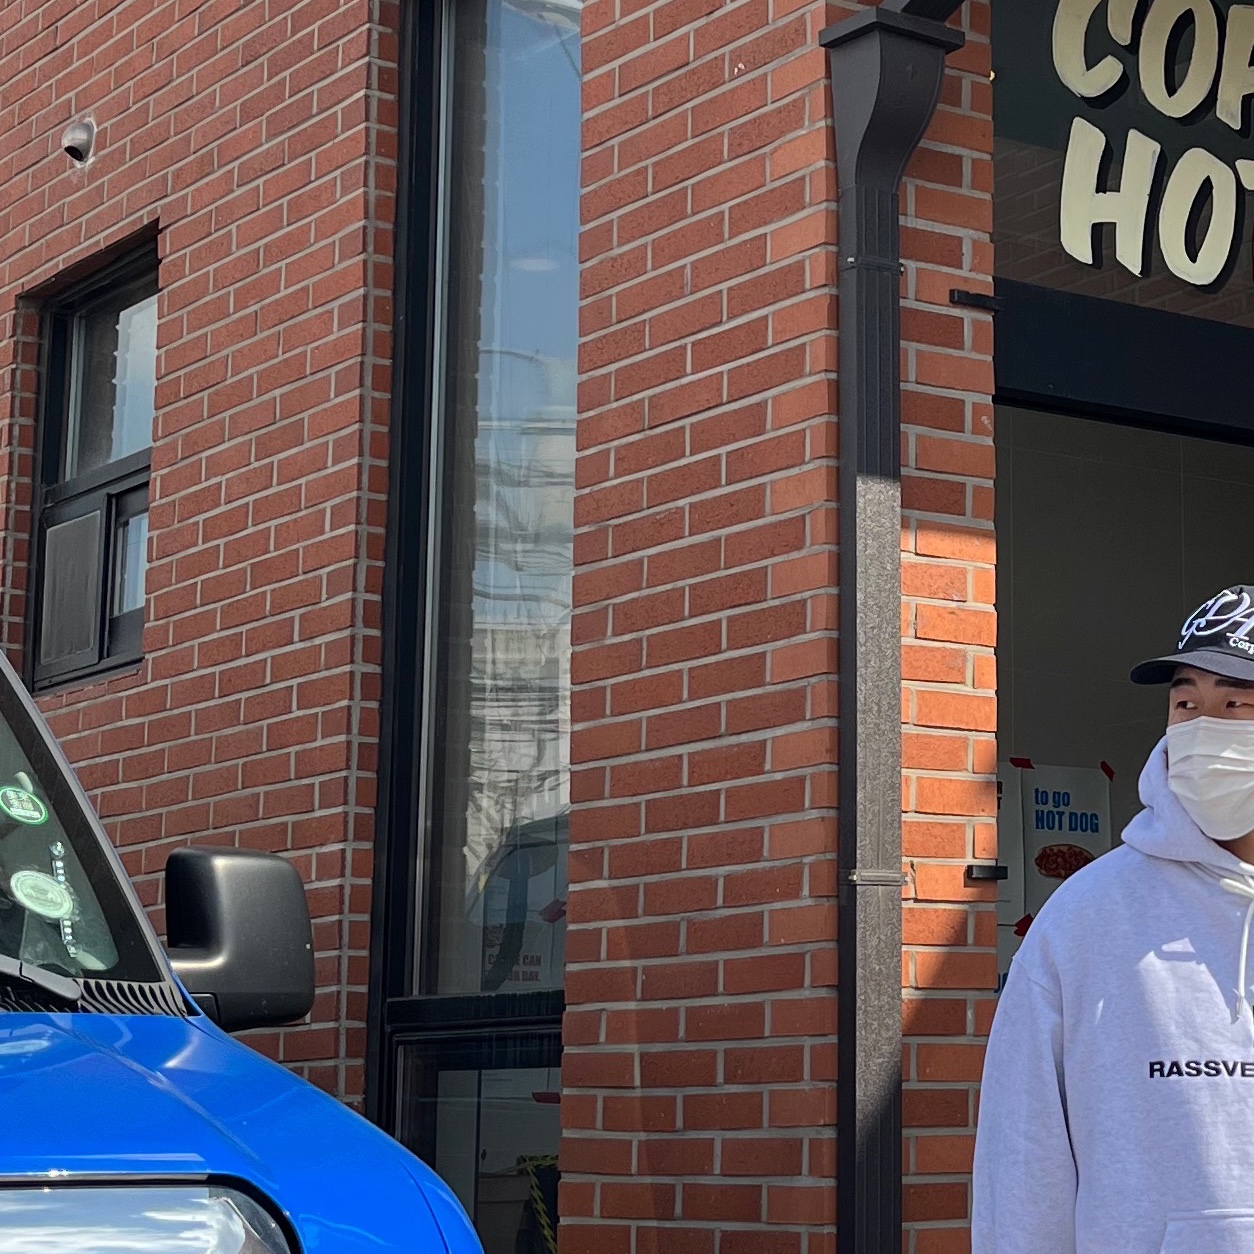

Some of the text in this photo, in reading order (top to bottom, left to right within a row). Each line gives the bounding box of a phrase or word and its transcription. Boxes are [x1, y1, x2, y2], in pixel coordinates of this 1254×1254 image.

[1034, 788, 1070, 809] to go
[1035, 809, 1099, 833] HOT DOG
